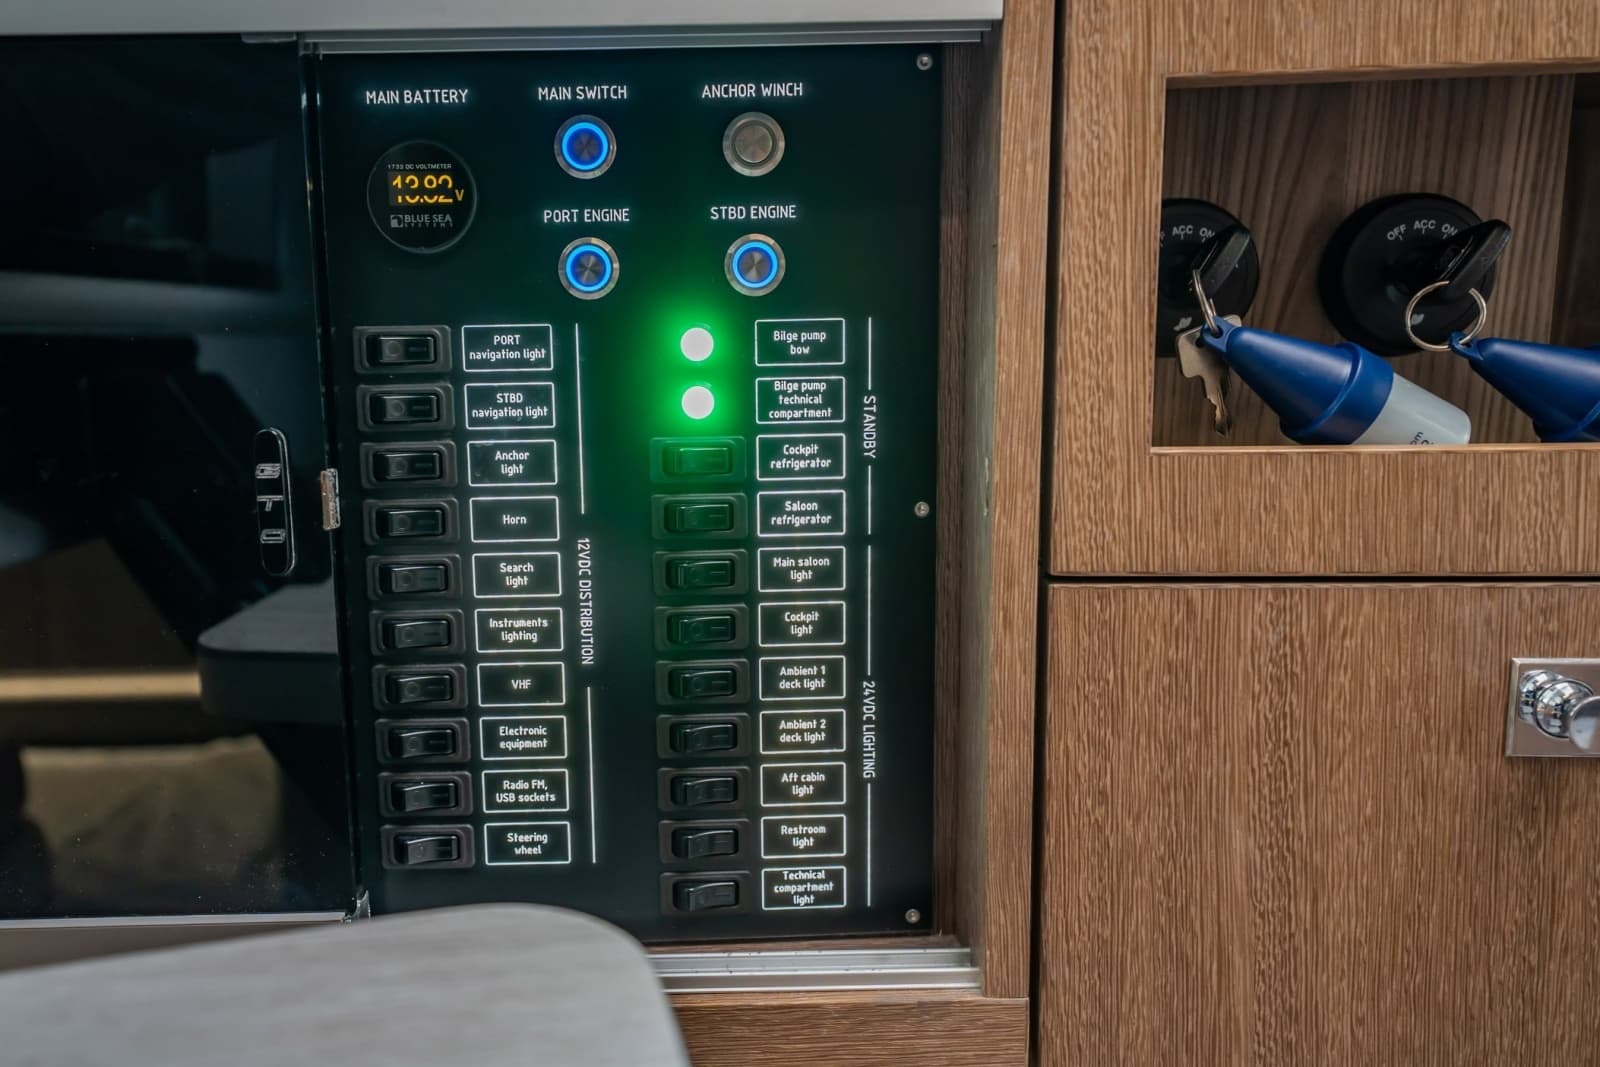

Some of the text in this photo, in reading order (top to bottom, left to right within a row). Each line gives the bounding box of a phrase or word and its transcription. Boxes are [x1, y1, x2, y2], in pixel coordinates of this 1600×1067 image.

[538, 85, 627, 101] MAIN SWITCH
[702, 82, 803, 98] ANCHOR WINCH
[365, 89, 468, 104] MAIN BATTERY
[455, 189, 464, 202] V
[404, 214, 453, 223] BLUE SEA
[544, 208, 630, 224] PORT ENGINE
[710, 205, 796, 220] STBD ENGINE
[1172, 225, 1194, 236] ACC
[1387, 220, 1458, 240] OFF ACC ON
[493, 335, 521, 345] PORT
[773, 331, 827, 343] Bilge pump
[469, 349, 546, 362] navigation light
[790, 344, 810, 355] bow
[774, 381, 827, 393] Bilge pump
[496, 393, 523, 403] STBD
[779, 394, 823, 405] technical
[472, 406, 548, 420] navigation light
[768, 407, 832, 419] compartment
[863, 395, 877, 458] STANDBY
[783, 444, 819, 455] Cockpit
[495, 451, 530, 461] Anchor
[501, 464, 524, 476] light
[770, 457, 832, 471] refrigerator
[785, 501, 818, 511] Saloon
[503, 515, 527, 525] Horn
[771, 514, 832, 527] refrigerator
[500, 563, 534, 573] Search
[773, 556, 830, 568] Main saloon
[506, 576, 528, 588] light
[790, 570, 813, 582] light
[577, 538, 594, 665] 12VDC DISTRIBUTION
[489, 617, 548, 628] Instruments
[784, 612, 820, 623] Cockpit
[501, 631, 538, 643] lighting
[791, 625, 814, 637] light
[780, 665, 826, 676] Ambient 1
[511, 679, 532, 690] VHF
[779, 678, 826, 691] deck light
[779, 719, 827, 730] Ambient 2
[863, 681, 876, 779] 24VDC LIGHTING
[499, 726, 548, 736] Electronic
[780, 731, 826, 744] deck light
[499, 739, 548, 751] equipment
[781, 772, 826, 783] Aft cabin
[503, 780, 548, 790] Radio FM,
[792, 785, 815, 797] light
[496, 792, 556, 803] USB sockets
[781, 825, 827, 835] Restroom
[507, 832, 548, 845] Steering
[792, 836, 815, 849] light
[514, 845, 542, 855] wheel
[782, 870, 826, 880] Technical
[774, 881, 834, 894] compartment
[793, 894, 816, 906] light
